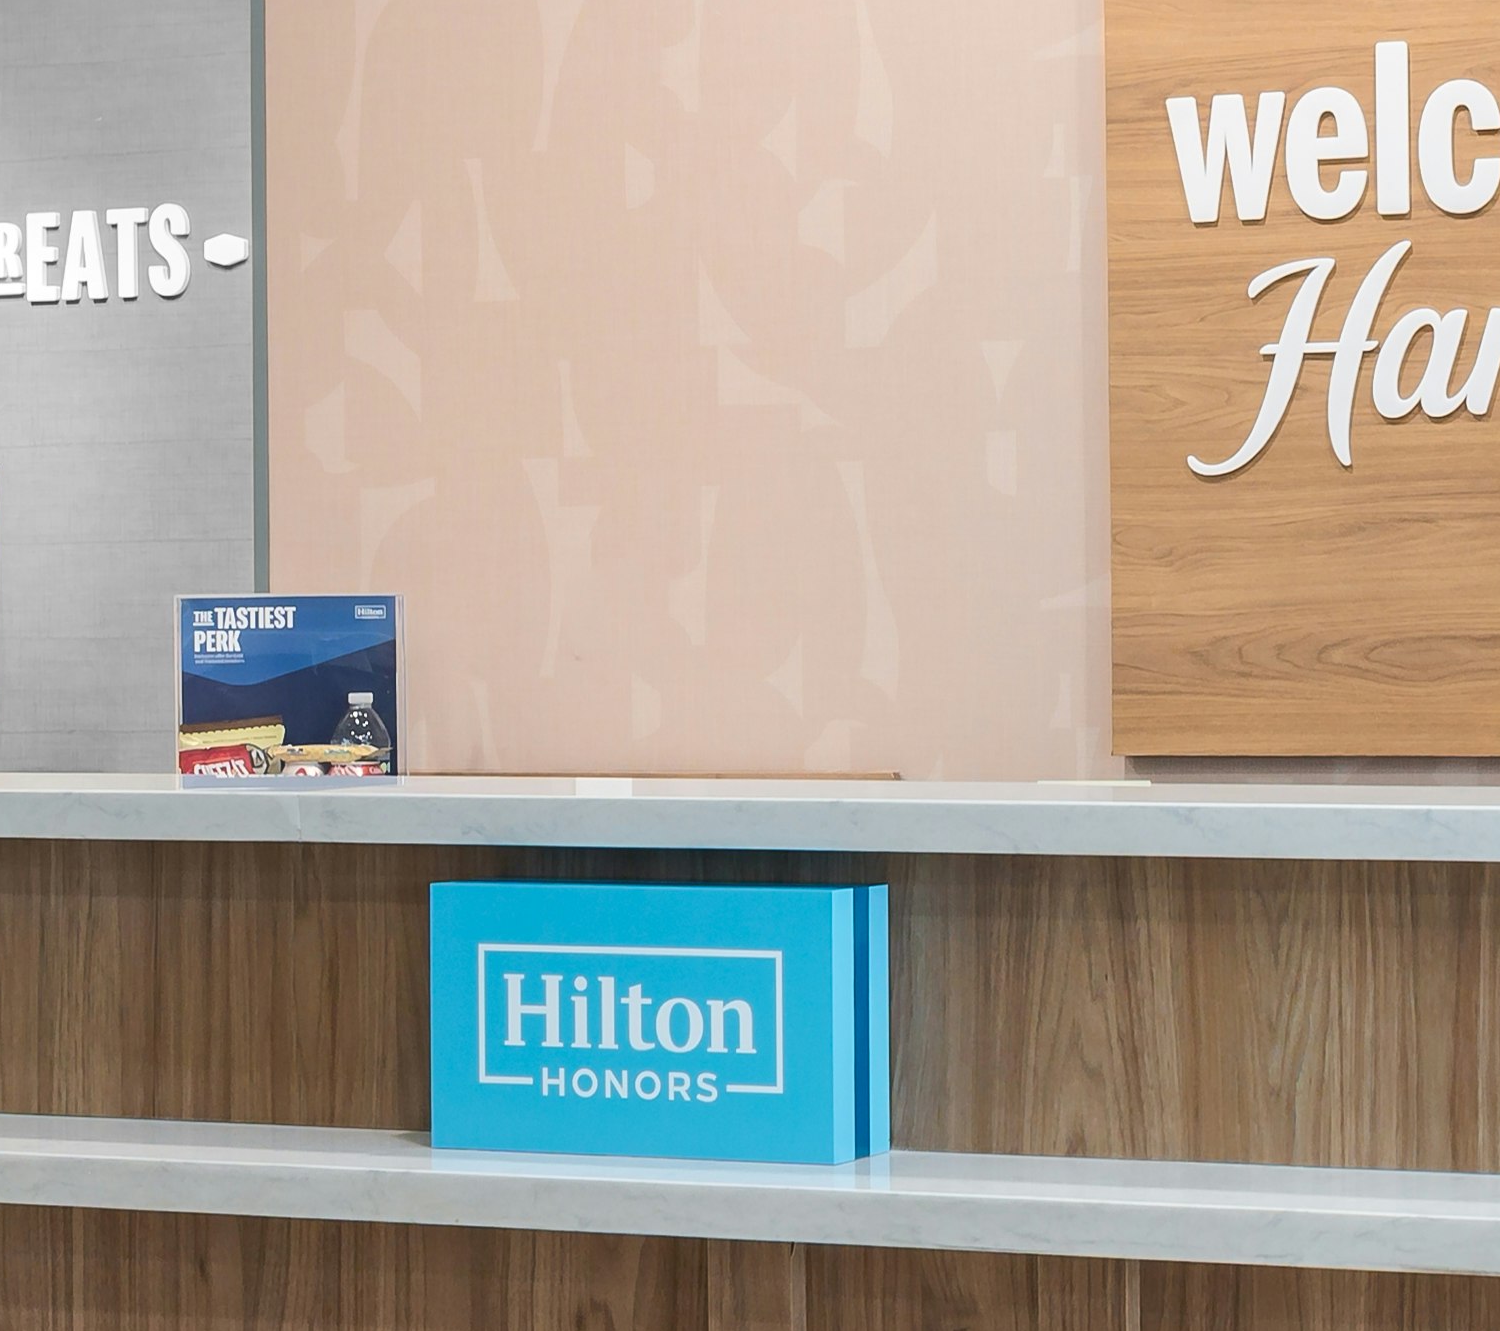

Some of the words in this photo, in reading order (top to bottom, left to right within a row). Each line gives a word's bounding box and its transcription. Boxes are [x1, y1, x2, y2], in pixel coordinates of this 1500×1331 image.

[194, 611, 213, 624] THE
[214, 606, 296, 629] TASTIEST
[194, 630, 241, 652] PERK
[503, 973, 758, 1055] Hilton
[541, 1066, 719, 1104] HONORS
